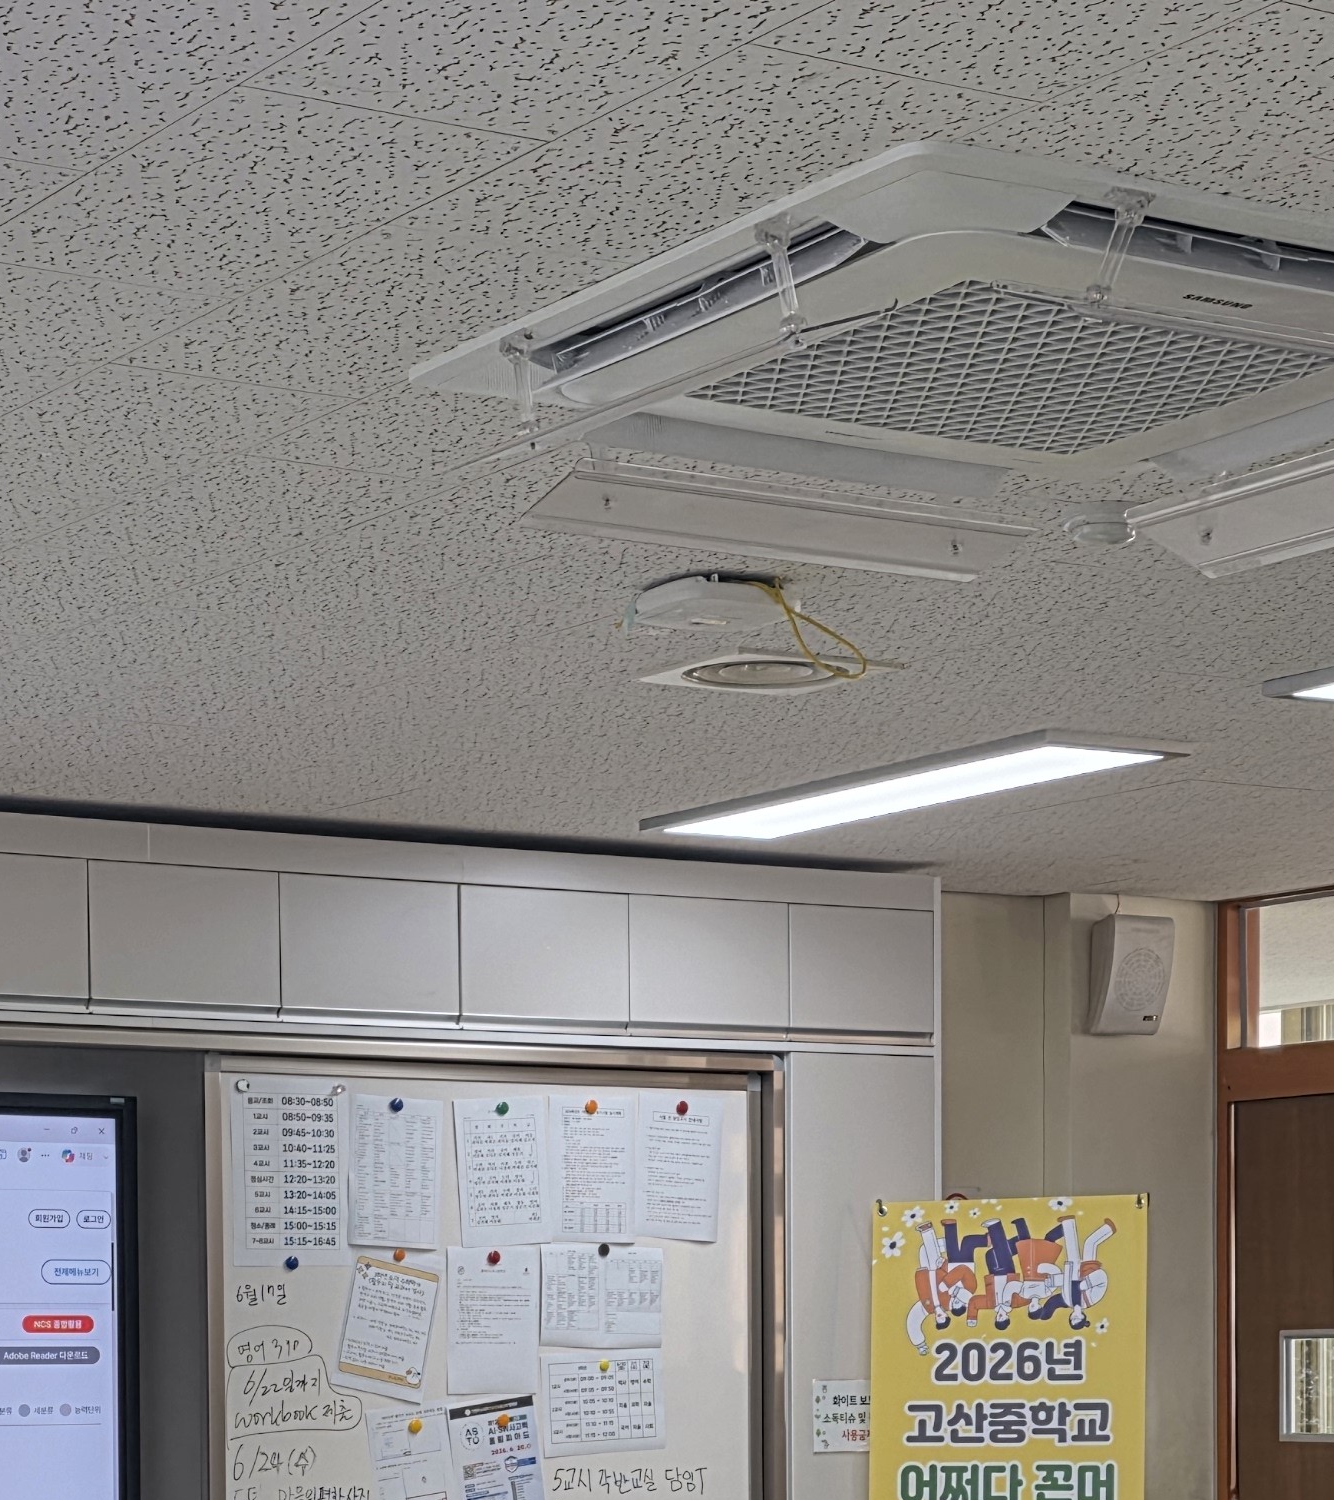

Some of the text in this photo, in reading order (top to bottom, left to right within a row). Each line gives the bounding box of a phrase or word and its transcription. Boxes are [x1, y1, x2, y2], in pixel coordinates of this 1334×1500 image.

[1182, 293, 1253, 309] SAMSUNG
[281, 1096, 334, 1107] 08:30~08:50
[282, 1112, 334, 1122] 08:50~09:35
[282, 1128, 335, 1138] 09:45~10:30
[282, 1143, 336, 1153] 10:40~11:25
[283, 1159, 335, 1169] 11:35~12:20
[283, 1174, 336, 1184] 12:20~13:20
[283, 1190, 336, 1200] 13:20~14:05
[283, 1205, 337, 1215] 14:15~15:00
[283, 1221, 337, 1231] 15:00~15:15
[283, 1236, 336, 1247] 15:15~16:45
[33, 1319, 51, 1329] NCS
[3, 1350, 28, 1360] Adobe
[30, 1350, 58, 1360] Reader
[933, 1339, 1084, 1382] 2026년
[832, 1394, 858, 1407] 화이트
[822, 1411, 856, 1424] 소독티슈
[906, 1400, 1111, 1444] 고산중학교
[552, 1467, 592, 1492] 5교시
